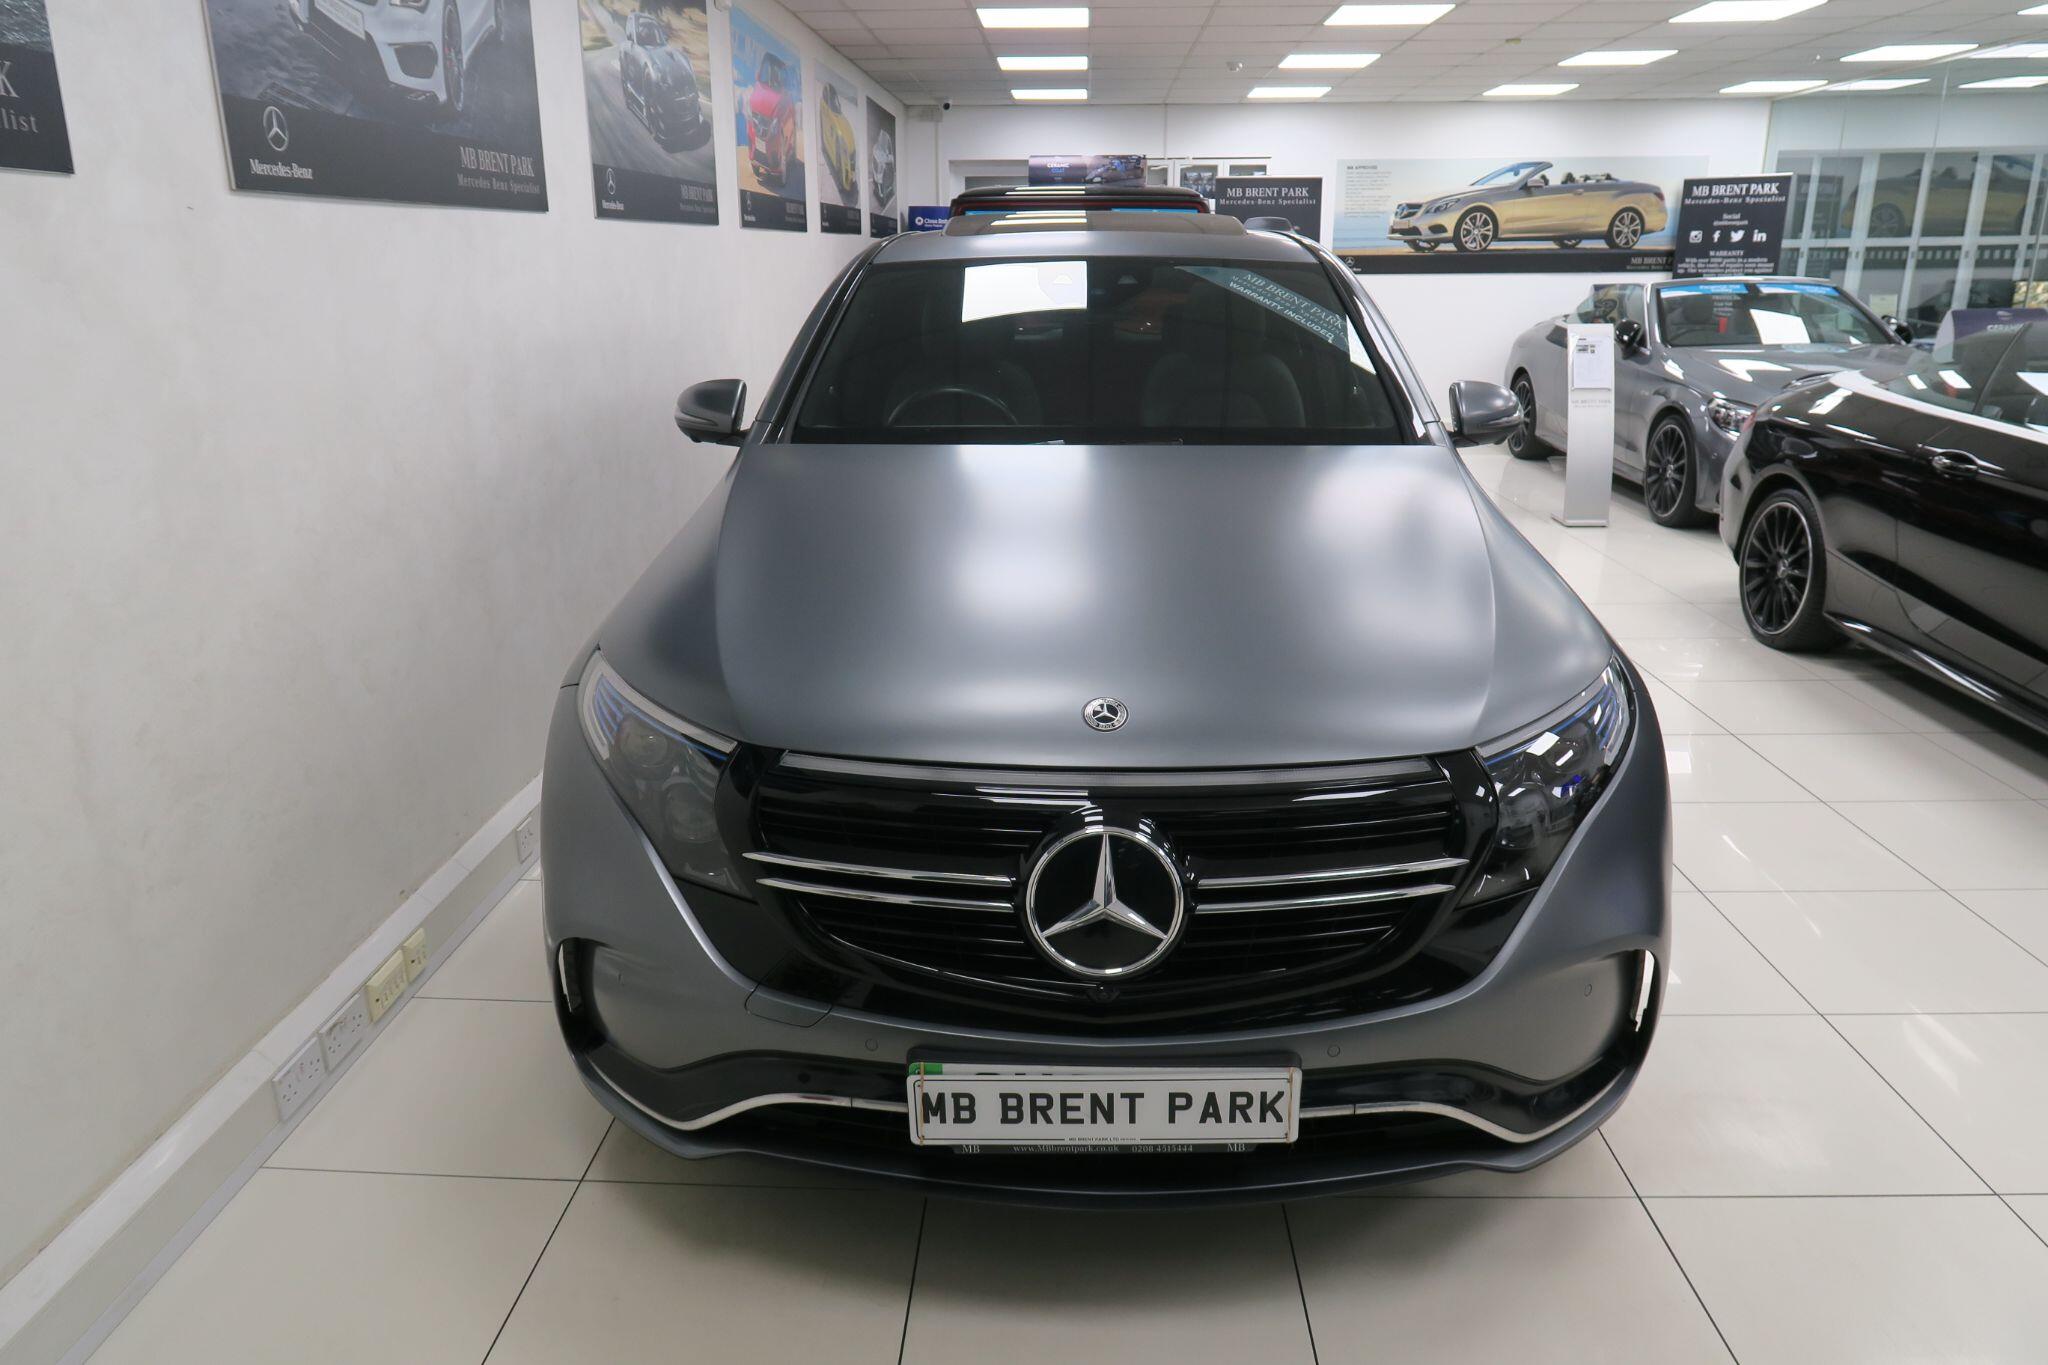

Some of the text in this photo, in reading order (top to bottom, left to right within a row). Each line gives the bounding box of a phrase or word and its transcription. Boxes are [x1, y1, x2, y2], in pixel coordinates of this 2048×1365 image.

[249, 159, 313, 179] Mercedes-Benz
[460, 146, 535, 177] MB BRENT PARK
[1227, 187, 1309, 197] MB BRENT PARK
[1692, 182, 1779, 196] MB BRENT PARK
[1745, 195, 1786, 204] Specialist
[1229, 281, 1335, 339] WARRANTY INCLUDED
[1243, 274, 1343, 328] MB BRENT PARK
[922, 1091, 1285, 1124] MB BRENT PARK
[962, 1145, 980, 1153] MB
[1132, 1144, 1153, 1152] 0208
[1227, 1143, 1245, 1151] MB
